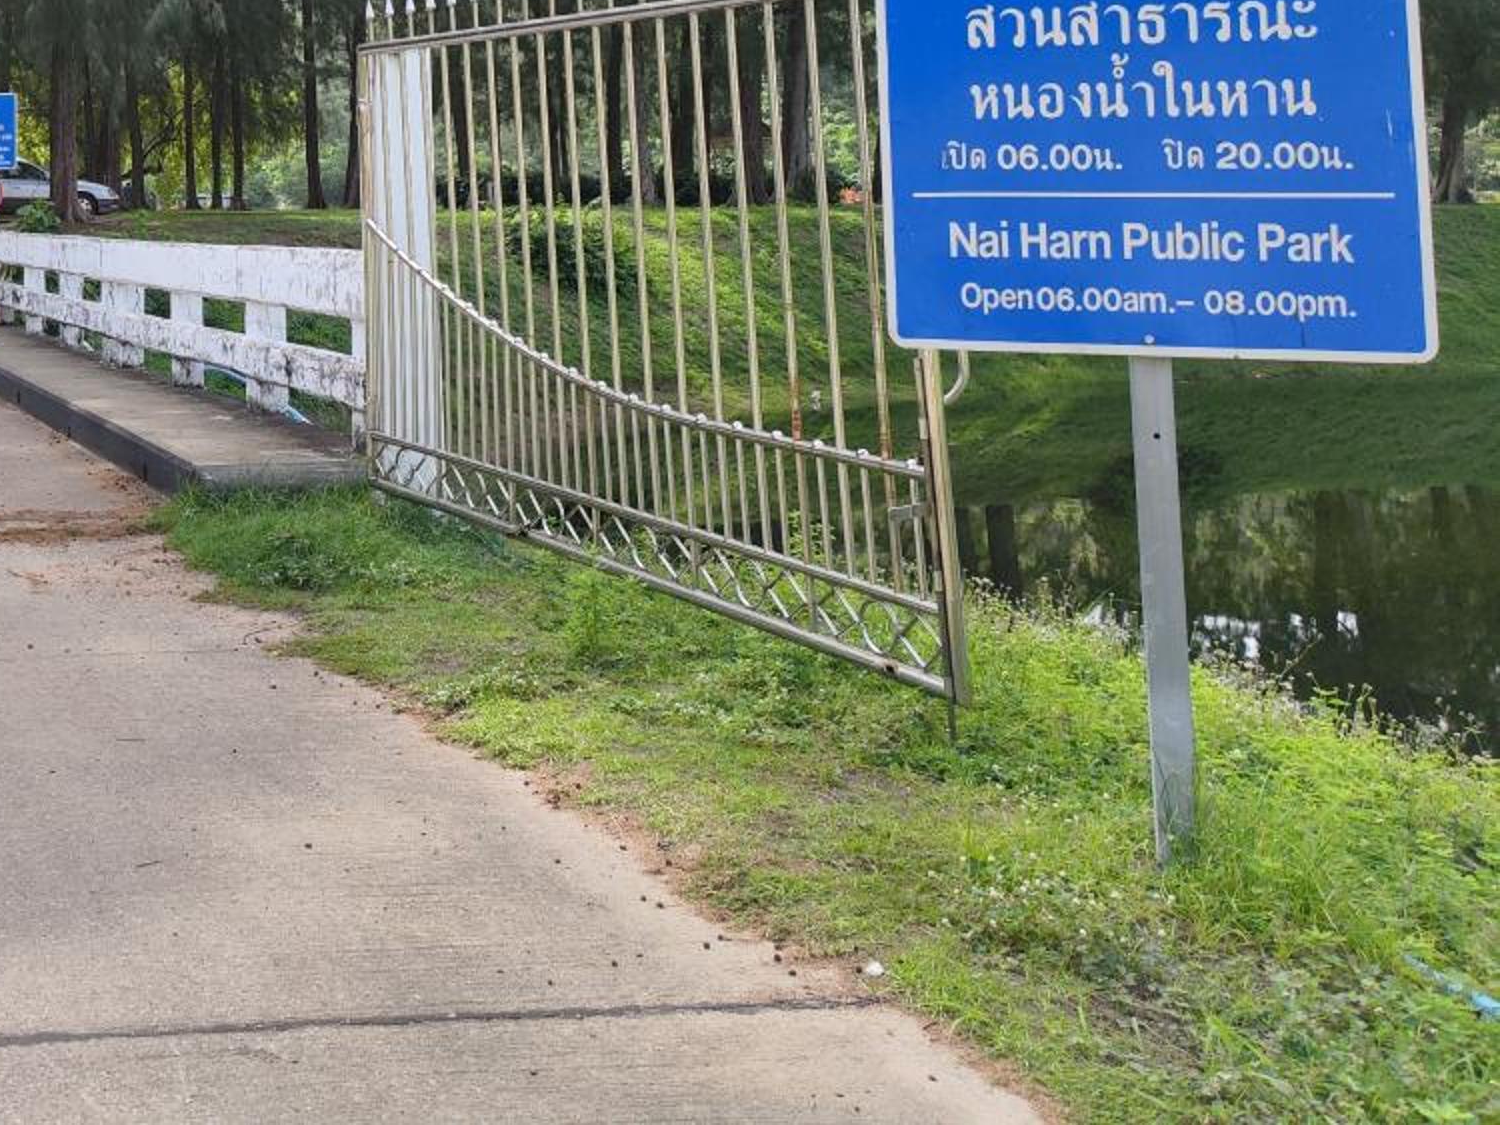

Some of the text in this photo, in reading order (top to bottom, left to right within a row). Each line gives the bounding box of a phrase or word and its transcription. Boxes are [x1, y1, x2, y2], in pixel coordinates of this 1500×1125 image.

[966, 0, 1318, 49] สวนสาธารณะ
[969, 52, 1318, 120] หนองน้ำในหาน
[996, 143, 1123, 172] 06.00น.
[1161, 138, 1205, 171] ปิด
[1215, 140, 1354, 172] 20.00น.
[948, 220, 1356, 265] Nai Harn Public Park
[1203, 289, 1357, 324] 08.00pm.
